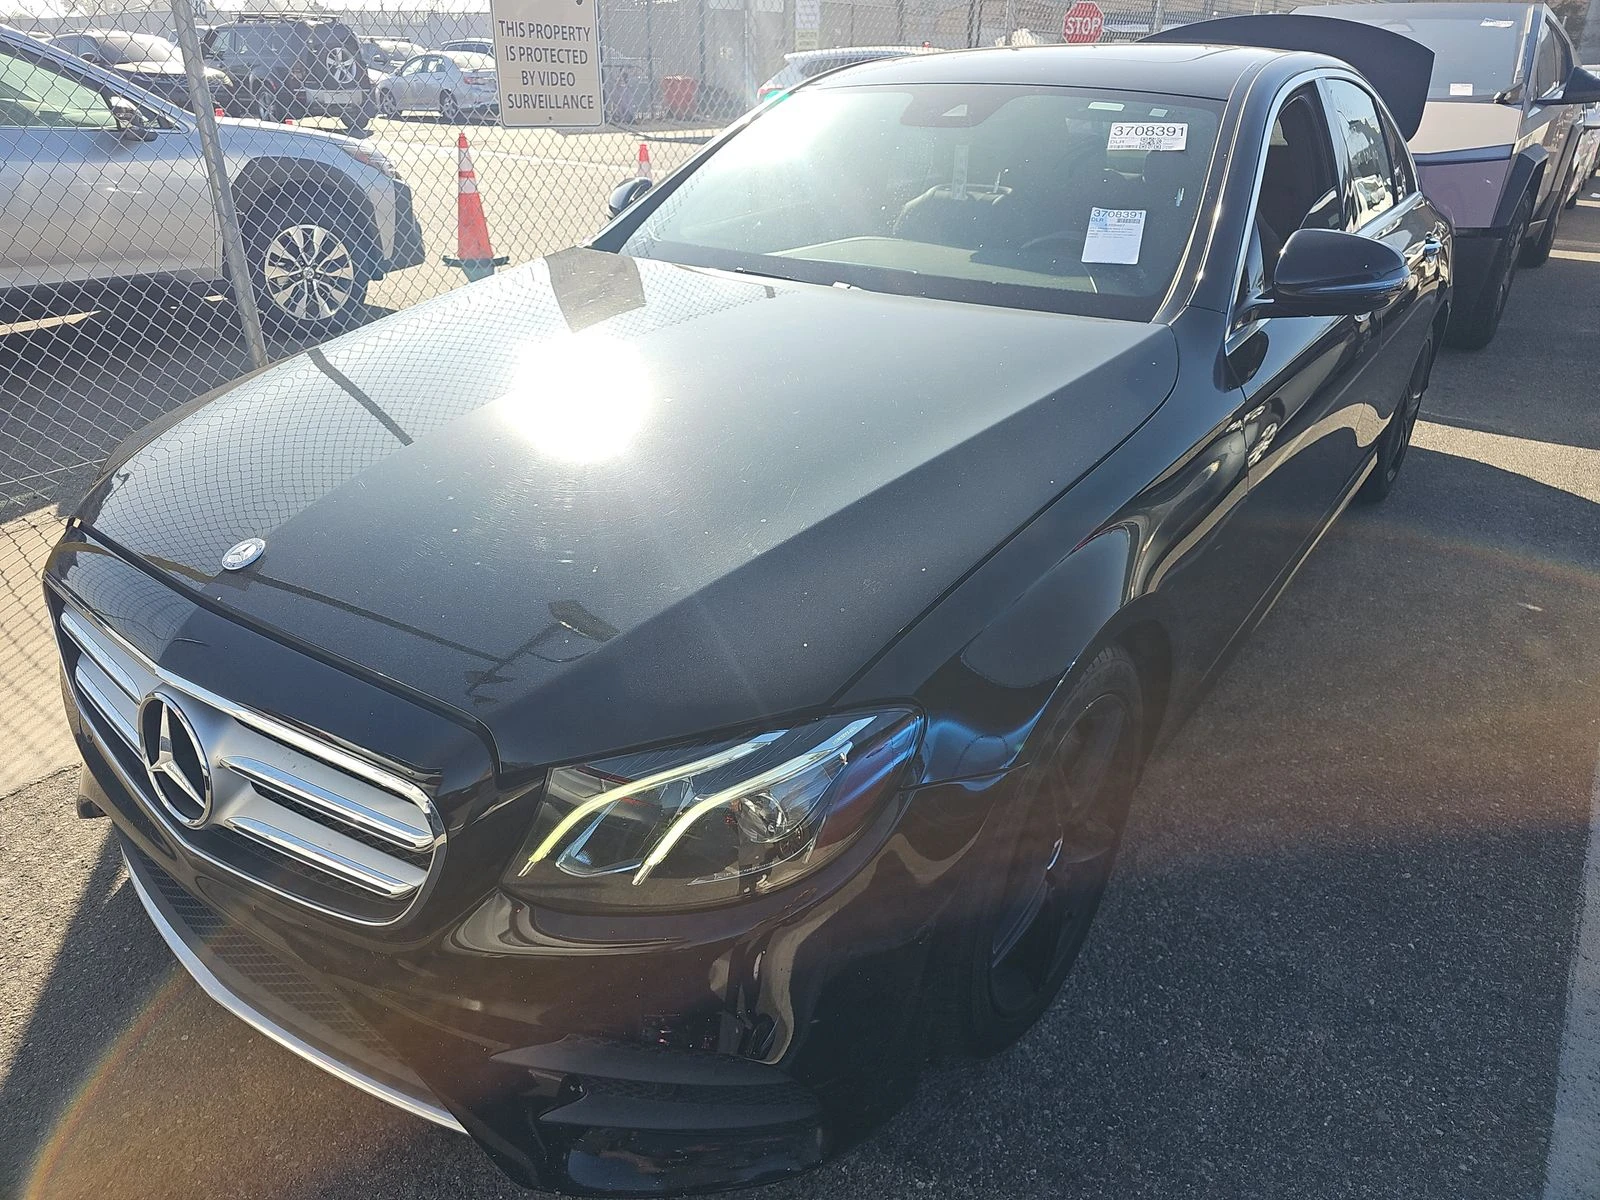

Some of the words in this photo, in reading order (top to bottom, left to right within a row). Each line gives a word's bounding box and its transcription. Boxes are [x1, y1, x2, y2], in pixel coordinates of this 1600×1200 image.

[498, 20, 525, 38] THIS
[528, 22, 591, 42] PROPERTY
[1065, 17, 1101, 35] STOP
[505, 45, 516, 61] IS
[519, 46, 588, 65] PROTECTED
[521, 70, 535, 86] BY
[538, 71, 576, 87] VIDEO
[507, 93, 594, 110] SURVEILLANCE
[1113, 125, 1184, 137] 3708391
[1093, 209, 1143, 219] 3708391
